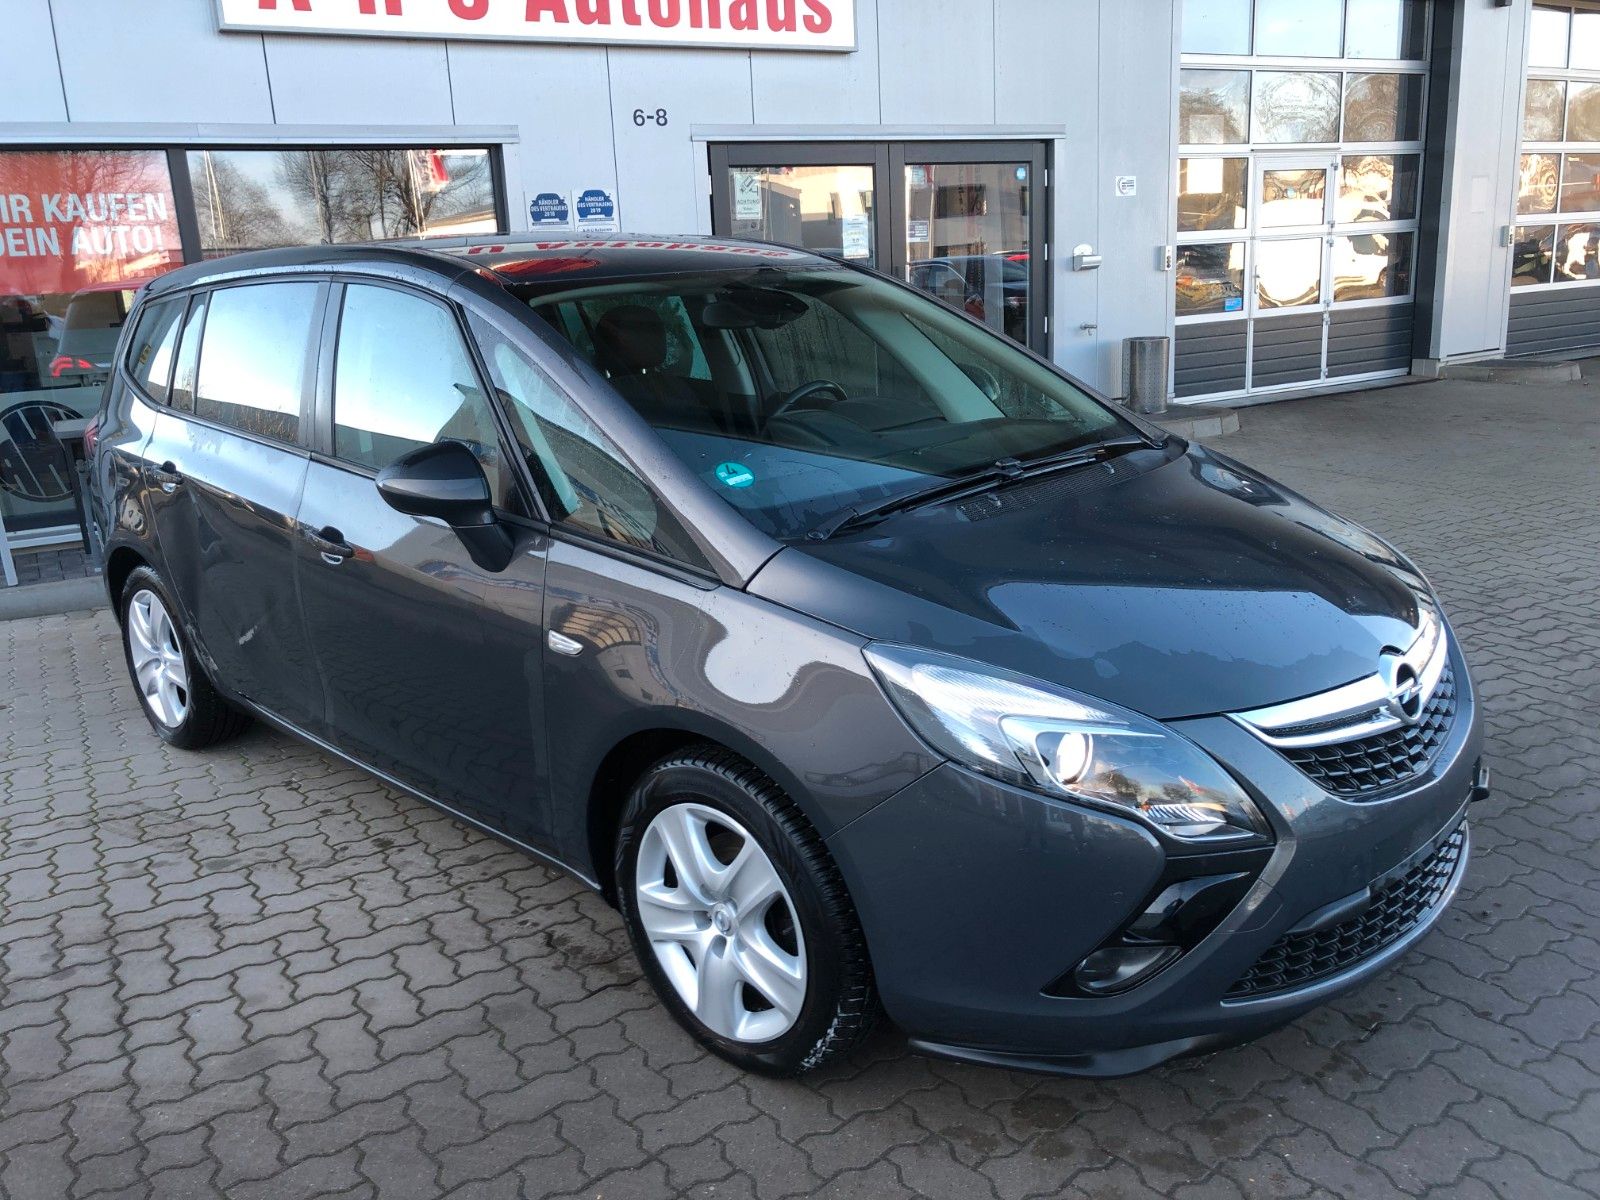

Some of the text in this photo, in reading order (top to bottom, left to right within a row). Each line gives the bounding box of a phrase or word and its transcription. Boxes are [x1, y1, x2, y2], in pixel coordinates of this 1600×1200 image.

[633, 108, 668, 127] 6-8
[41, 192, 168, 223] KAUFEN
[72, 224, 164, 256] AUTO!
